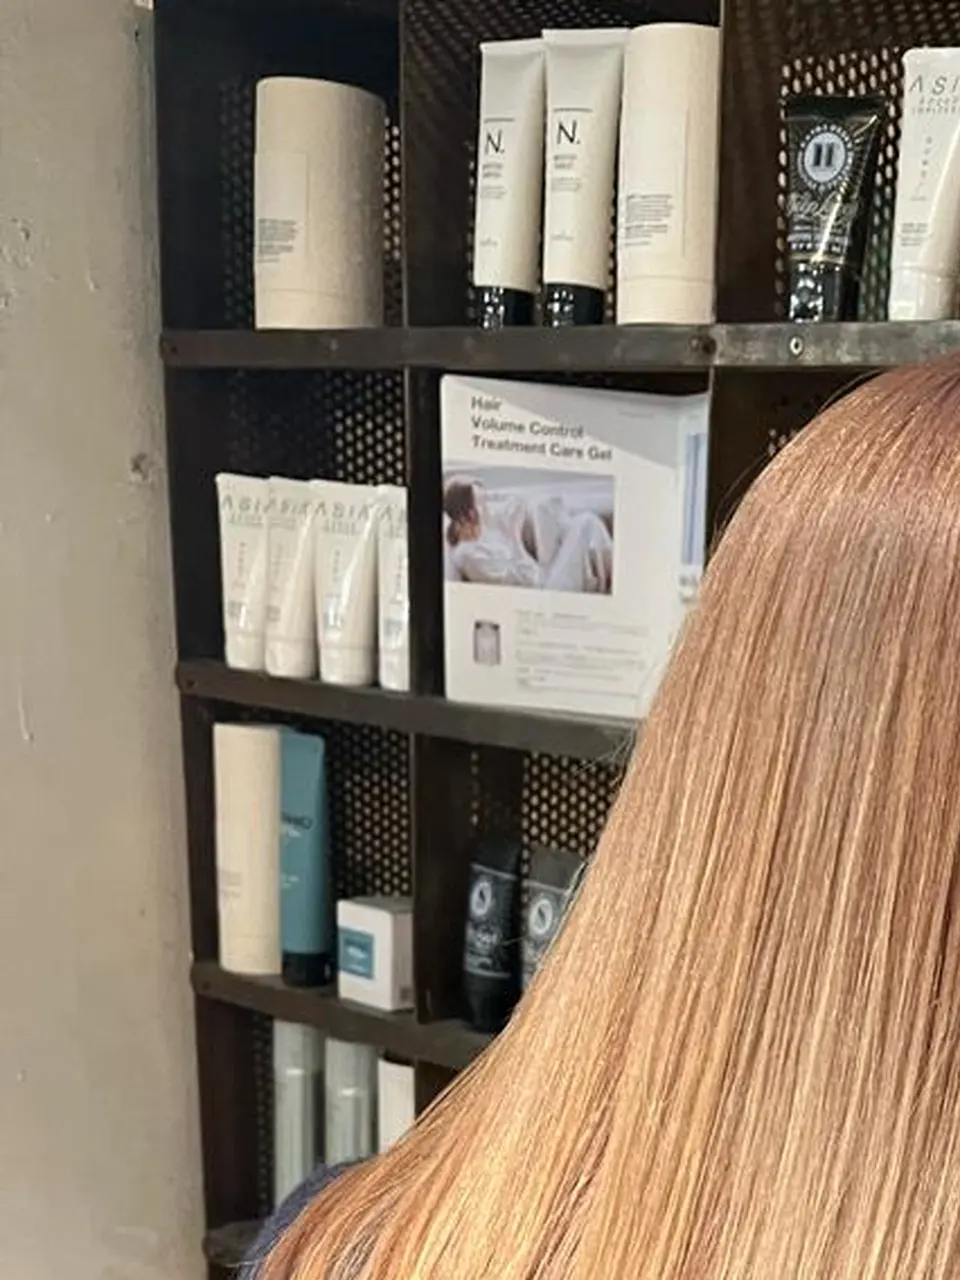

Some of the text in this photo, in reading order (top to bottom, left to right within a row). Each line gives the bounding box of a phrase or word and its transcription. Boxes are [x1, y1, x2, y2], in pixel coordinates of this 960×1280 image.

[485, 129, 505, 155] N.
[557, 119, 581, 145] N.
[471, 396, 502, 410] Hair
[471, 416, 584, 438] Volume Control
[472, 435, 612, 461] Treatment Care Gel
